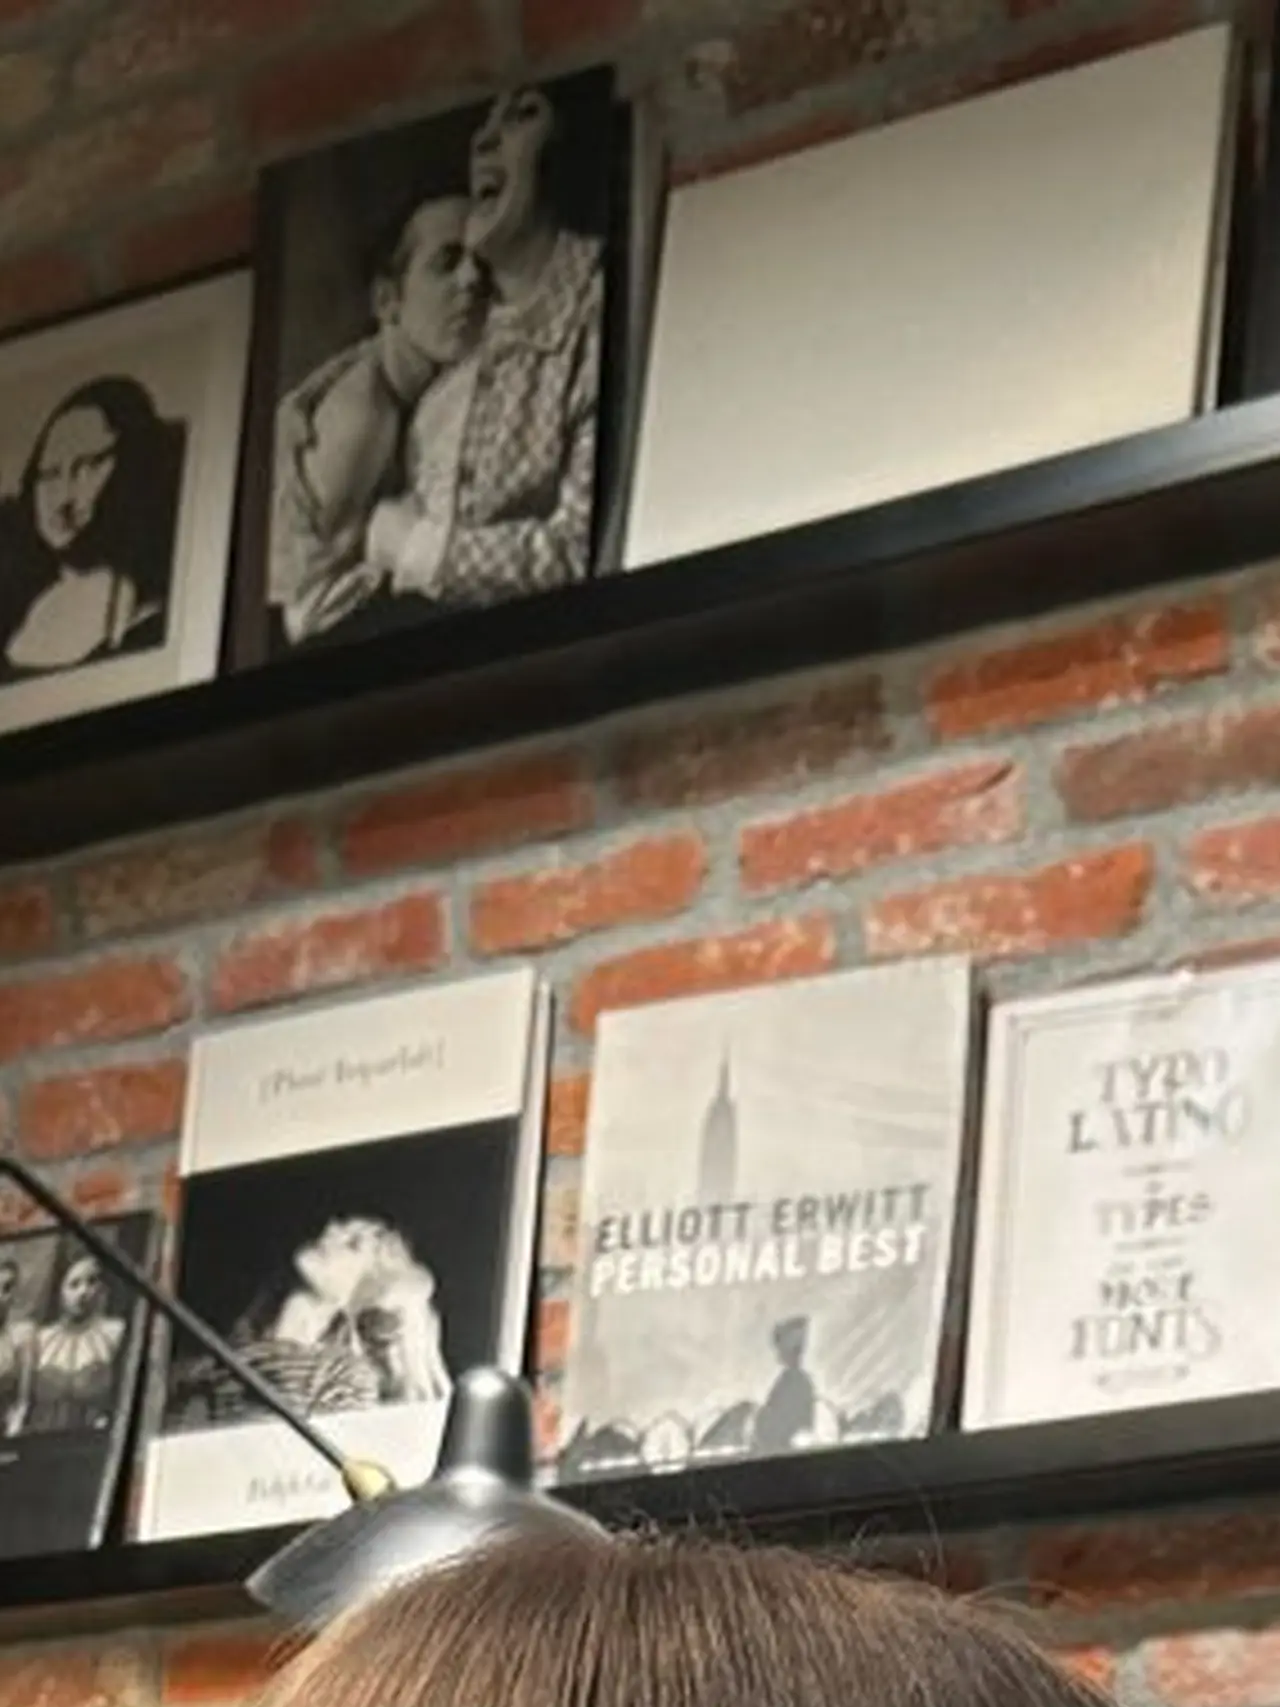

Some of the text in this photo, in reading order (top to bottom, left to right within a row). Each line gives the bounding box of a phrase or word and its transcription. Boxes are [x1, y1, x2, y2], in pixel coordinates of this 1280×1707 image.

[594, 1182, 932, 1255] ELLIOTT ERWITT
[590, 1223, 926, 1299] PERSONAL BEST
